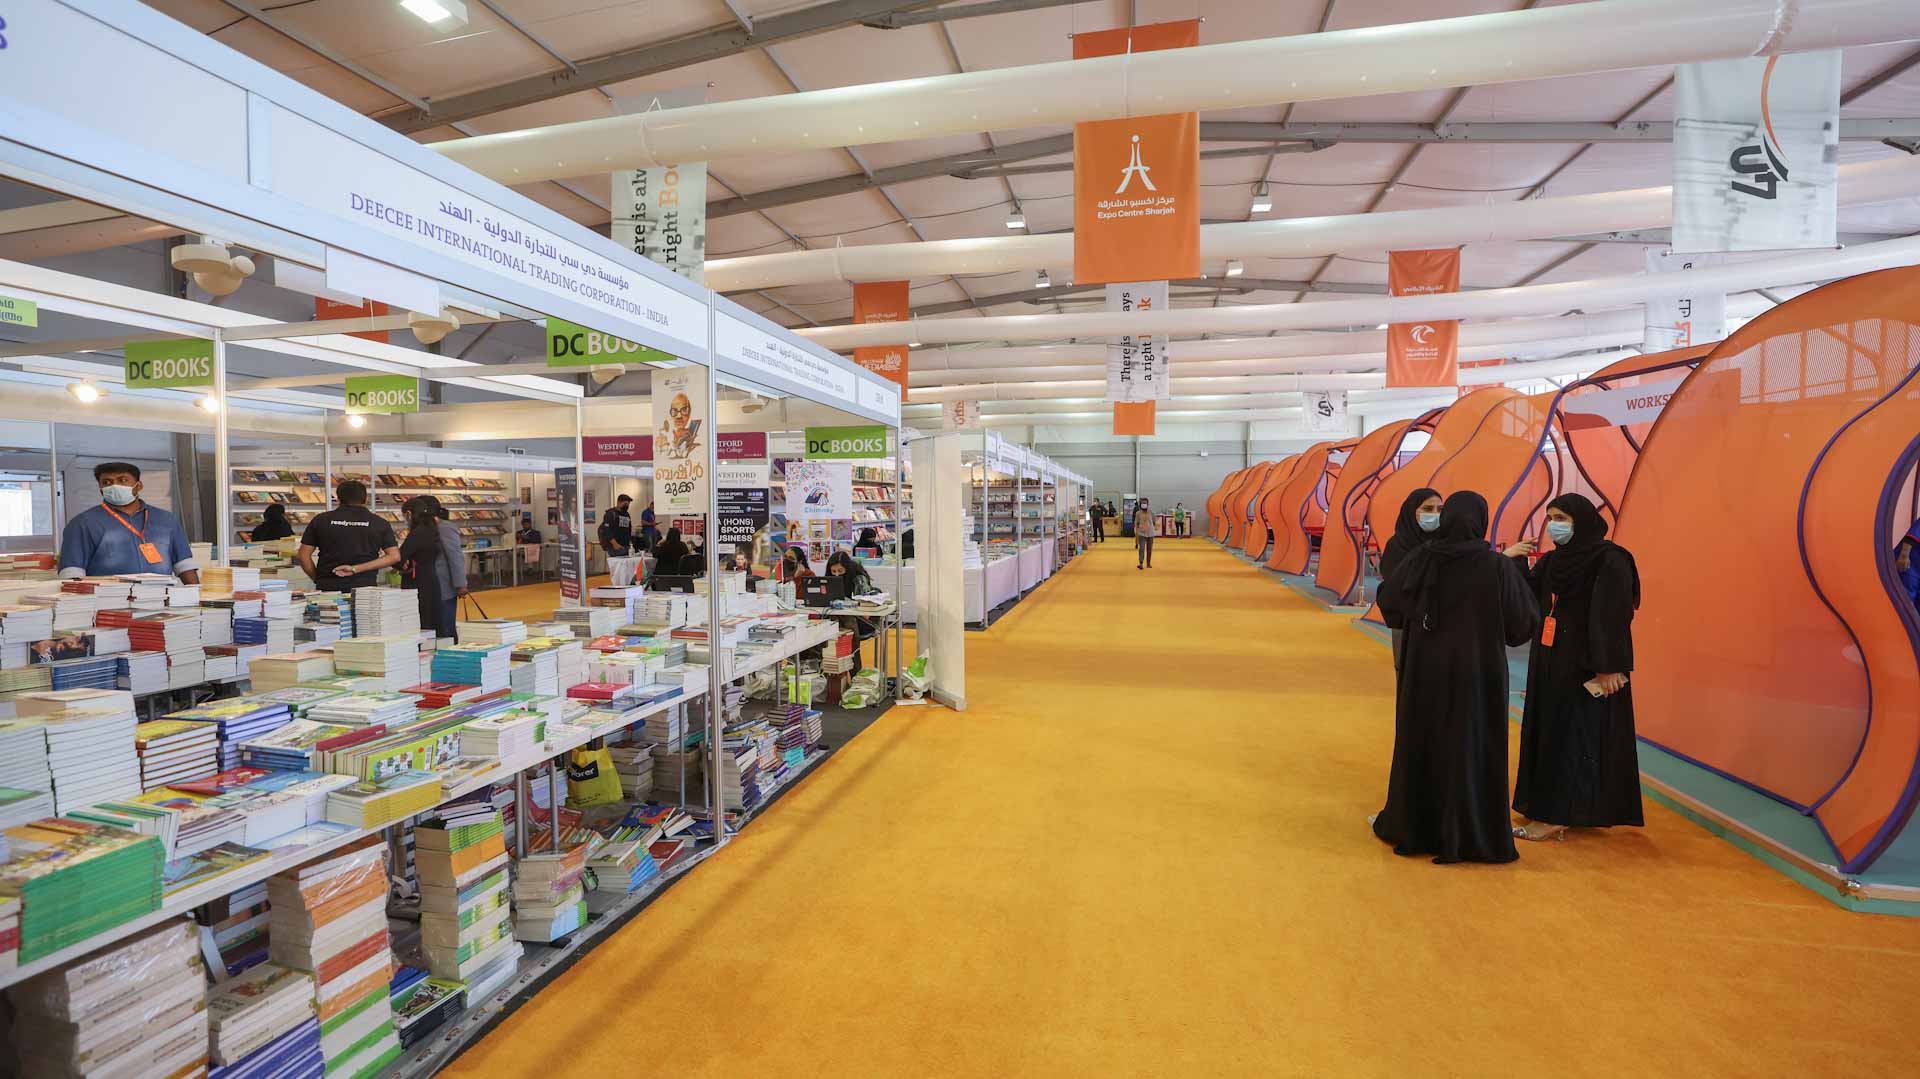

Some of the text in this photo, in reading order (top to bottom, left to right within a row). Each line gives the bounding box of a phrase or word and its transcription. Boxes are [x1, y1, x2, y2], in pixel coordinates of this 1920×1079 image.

[440, 200, 472, 225] الهند
[632, 202, 646, 221] is
[1097, 205, 1175, 219] Expo Centre Sharjah
[484, 217, 522, 244] الدولية
[634, 223, 646, 256] ere
[663, 211, 682, 263] right
[525, 236, 557, 259] للتجارة
[350, 192, 413, 231] DEECEE
[417, 218, 527, 274] INTERNATIONAL
[529, 263, 578, 293] TRADING
[579, 283, 641, 316] CORPORATION
[646, 308, 669, 327] INDIA
[598, 267, 629, 290] مؤسسة
[1120, 291, 1133, 382] There is ays
[1141, 342, 1155, 374] right
[597, 442, 635, 450] WESTFORD
[718, 440, 743, 448] TFORD
[721, 526, 756, 534] SPORTS
[723, 517, 754, 527] (HONS)
